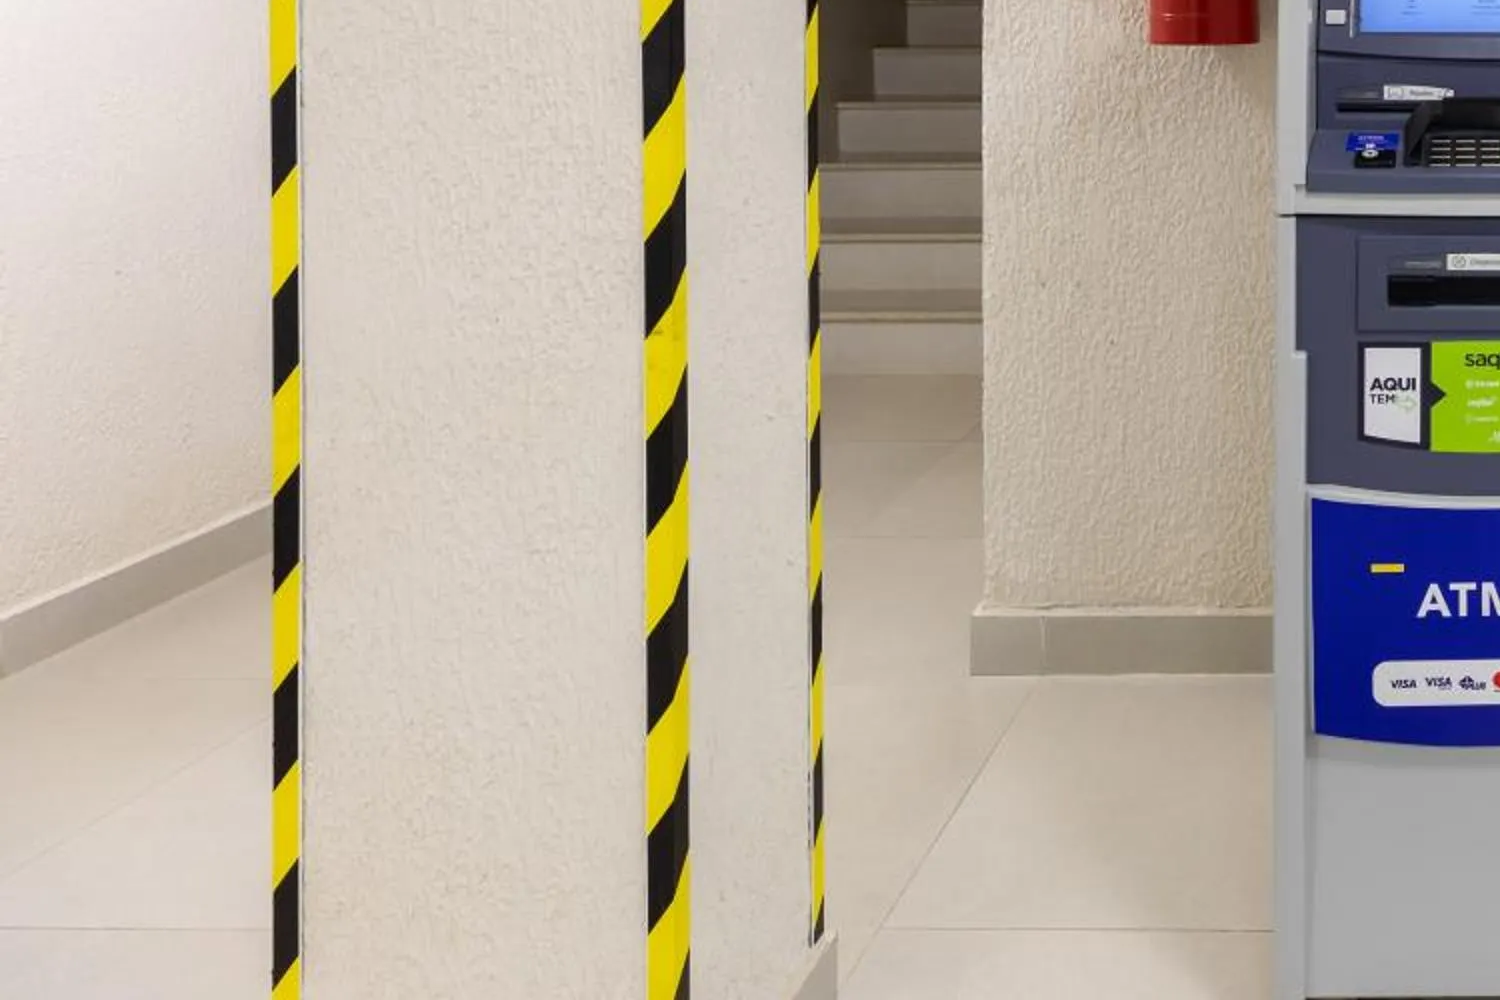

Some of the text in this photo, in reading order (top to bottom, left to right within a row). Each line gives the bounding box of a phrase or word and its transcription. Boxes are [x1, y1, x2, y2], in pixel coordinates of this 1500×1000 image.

[1369, 377, 1417, 391] AQUI
[1391, 679, 1417, 689] VISA
[1425, 676, 1452, 688] VISA
